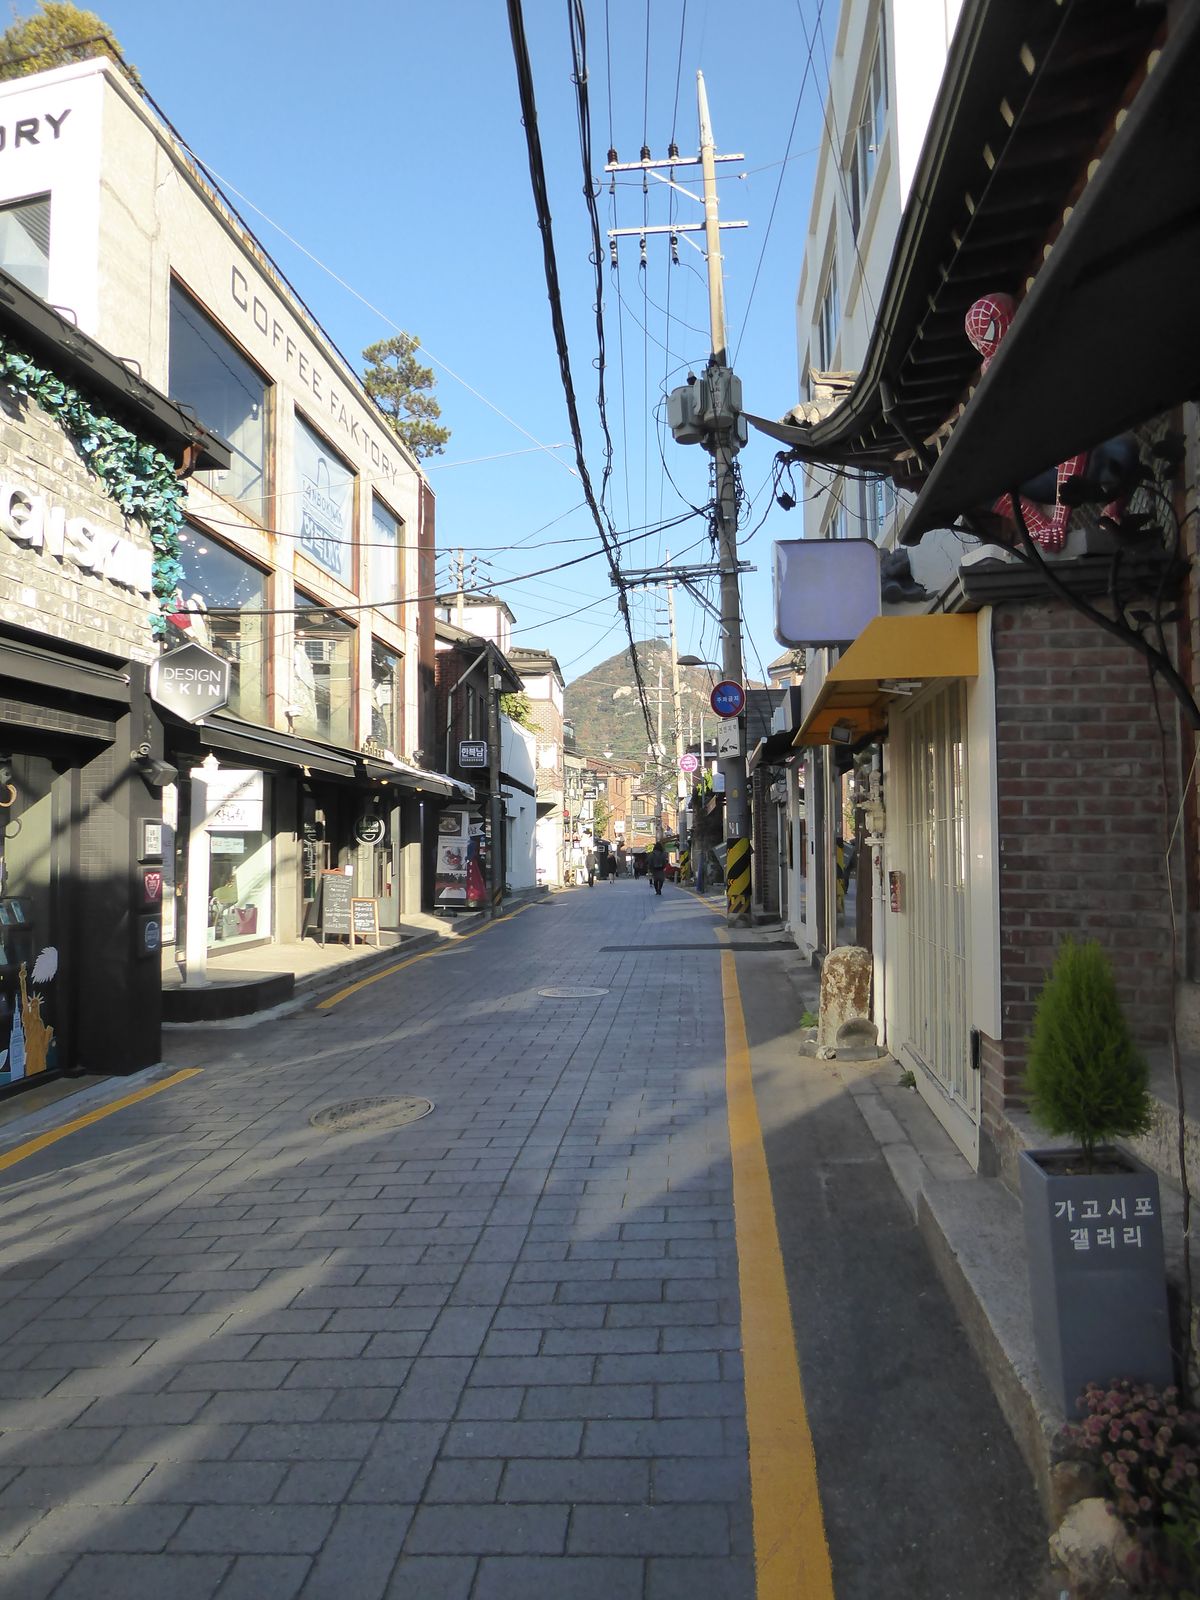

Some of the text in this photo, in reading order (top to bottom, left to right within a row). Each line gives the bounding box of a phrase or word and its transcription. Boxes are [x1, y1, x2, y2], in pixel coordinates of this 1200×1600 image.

[0, 108, 72, 152] RY
[231, 264, 398, 486] COFFEE FAKTORY
[163, 667, 221, 681] DESIGN
[163, 682, 220, 696] SKIN
[716, 695, 739, 703] 주차금지
[1054, 1197, 1154, 1222] 가고시포
[1070, 1225, 1142, 1250] 갤러리
